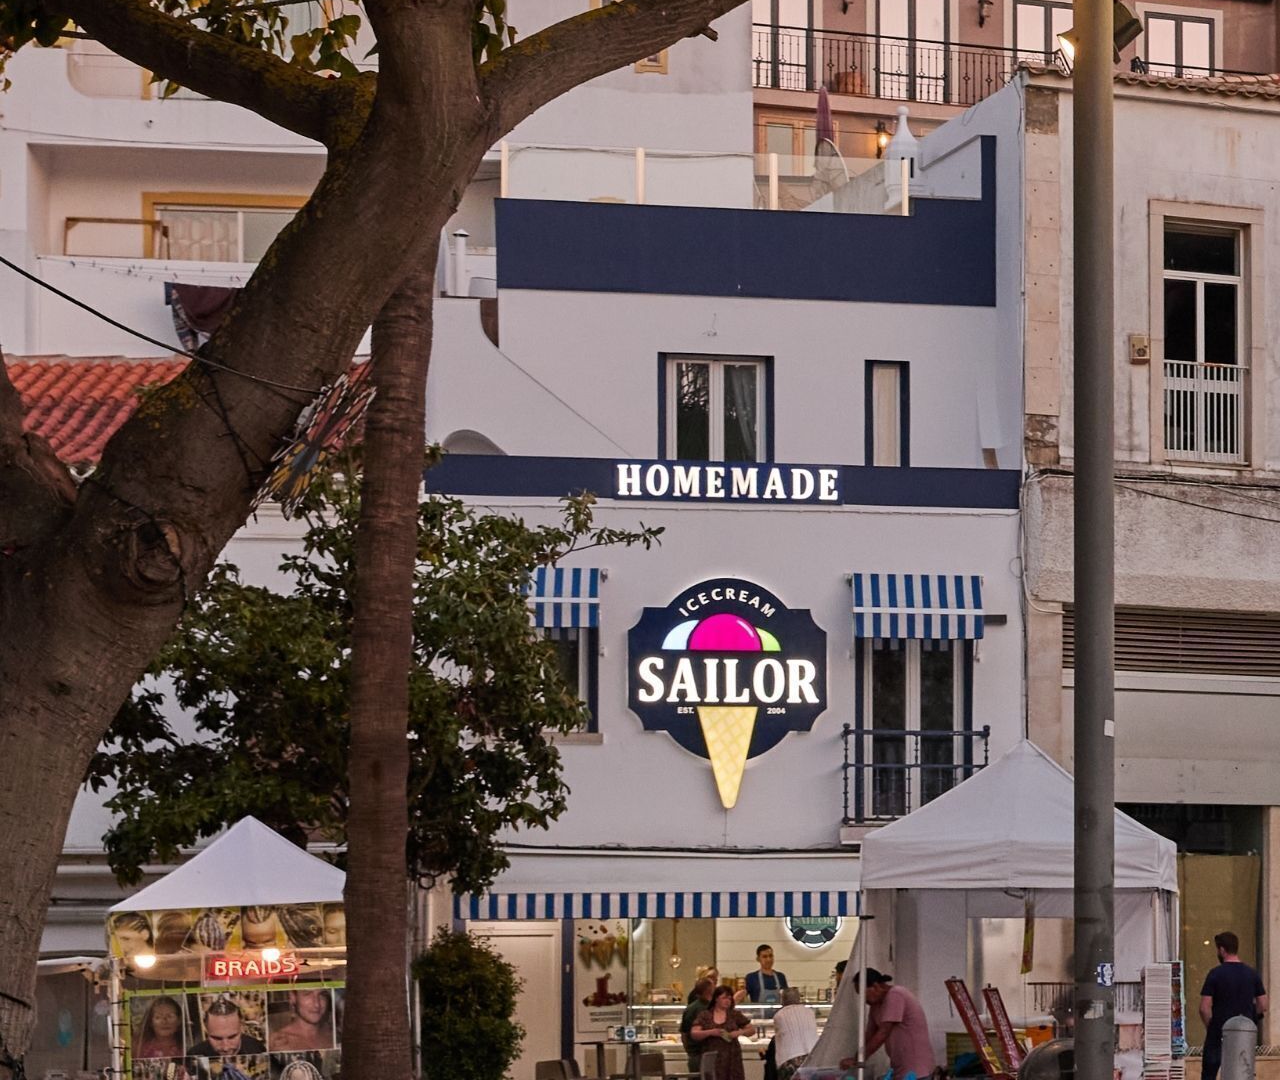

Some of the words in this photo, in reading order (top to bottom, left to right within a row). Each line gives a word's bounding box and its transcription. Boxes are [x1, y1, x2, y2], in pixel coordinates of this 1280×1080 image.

[617, 464, 839, 501] HOMEMADE
[678, 587, 776, 618] ICECREAM
[638, 656, 820, 704] SAILOR
[767, 707, 786, 715] 2004
[214, 957, 297, 977] BRAIDS
